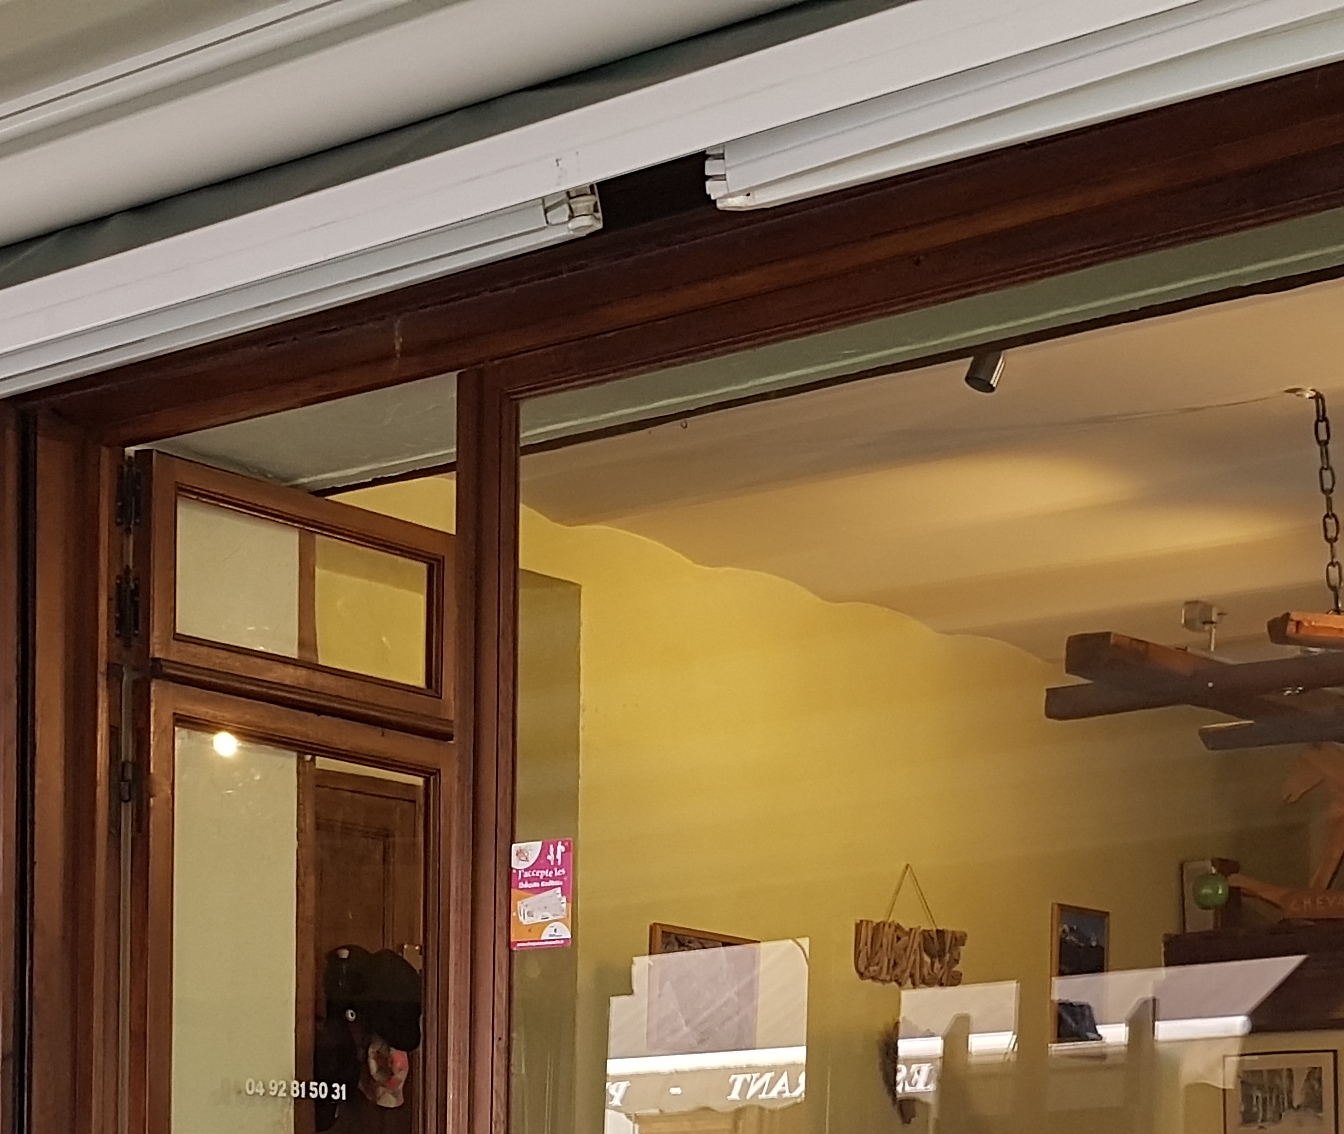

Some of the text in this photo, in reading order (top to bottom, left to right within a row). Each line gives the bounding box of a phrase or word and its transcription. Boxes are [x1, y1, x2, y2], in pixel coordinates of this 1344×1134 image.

[517, 867, 566, 880] J'accepte les
[246, 1078, 346, 1100] 04 92 81 50 31
